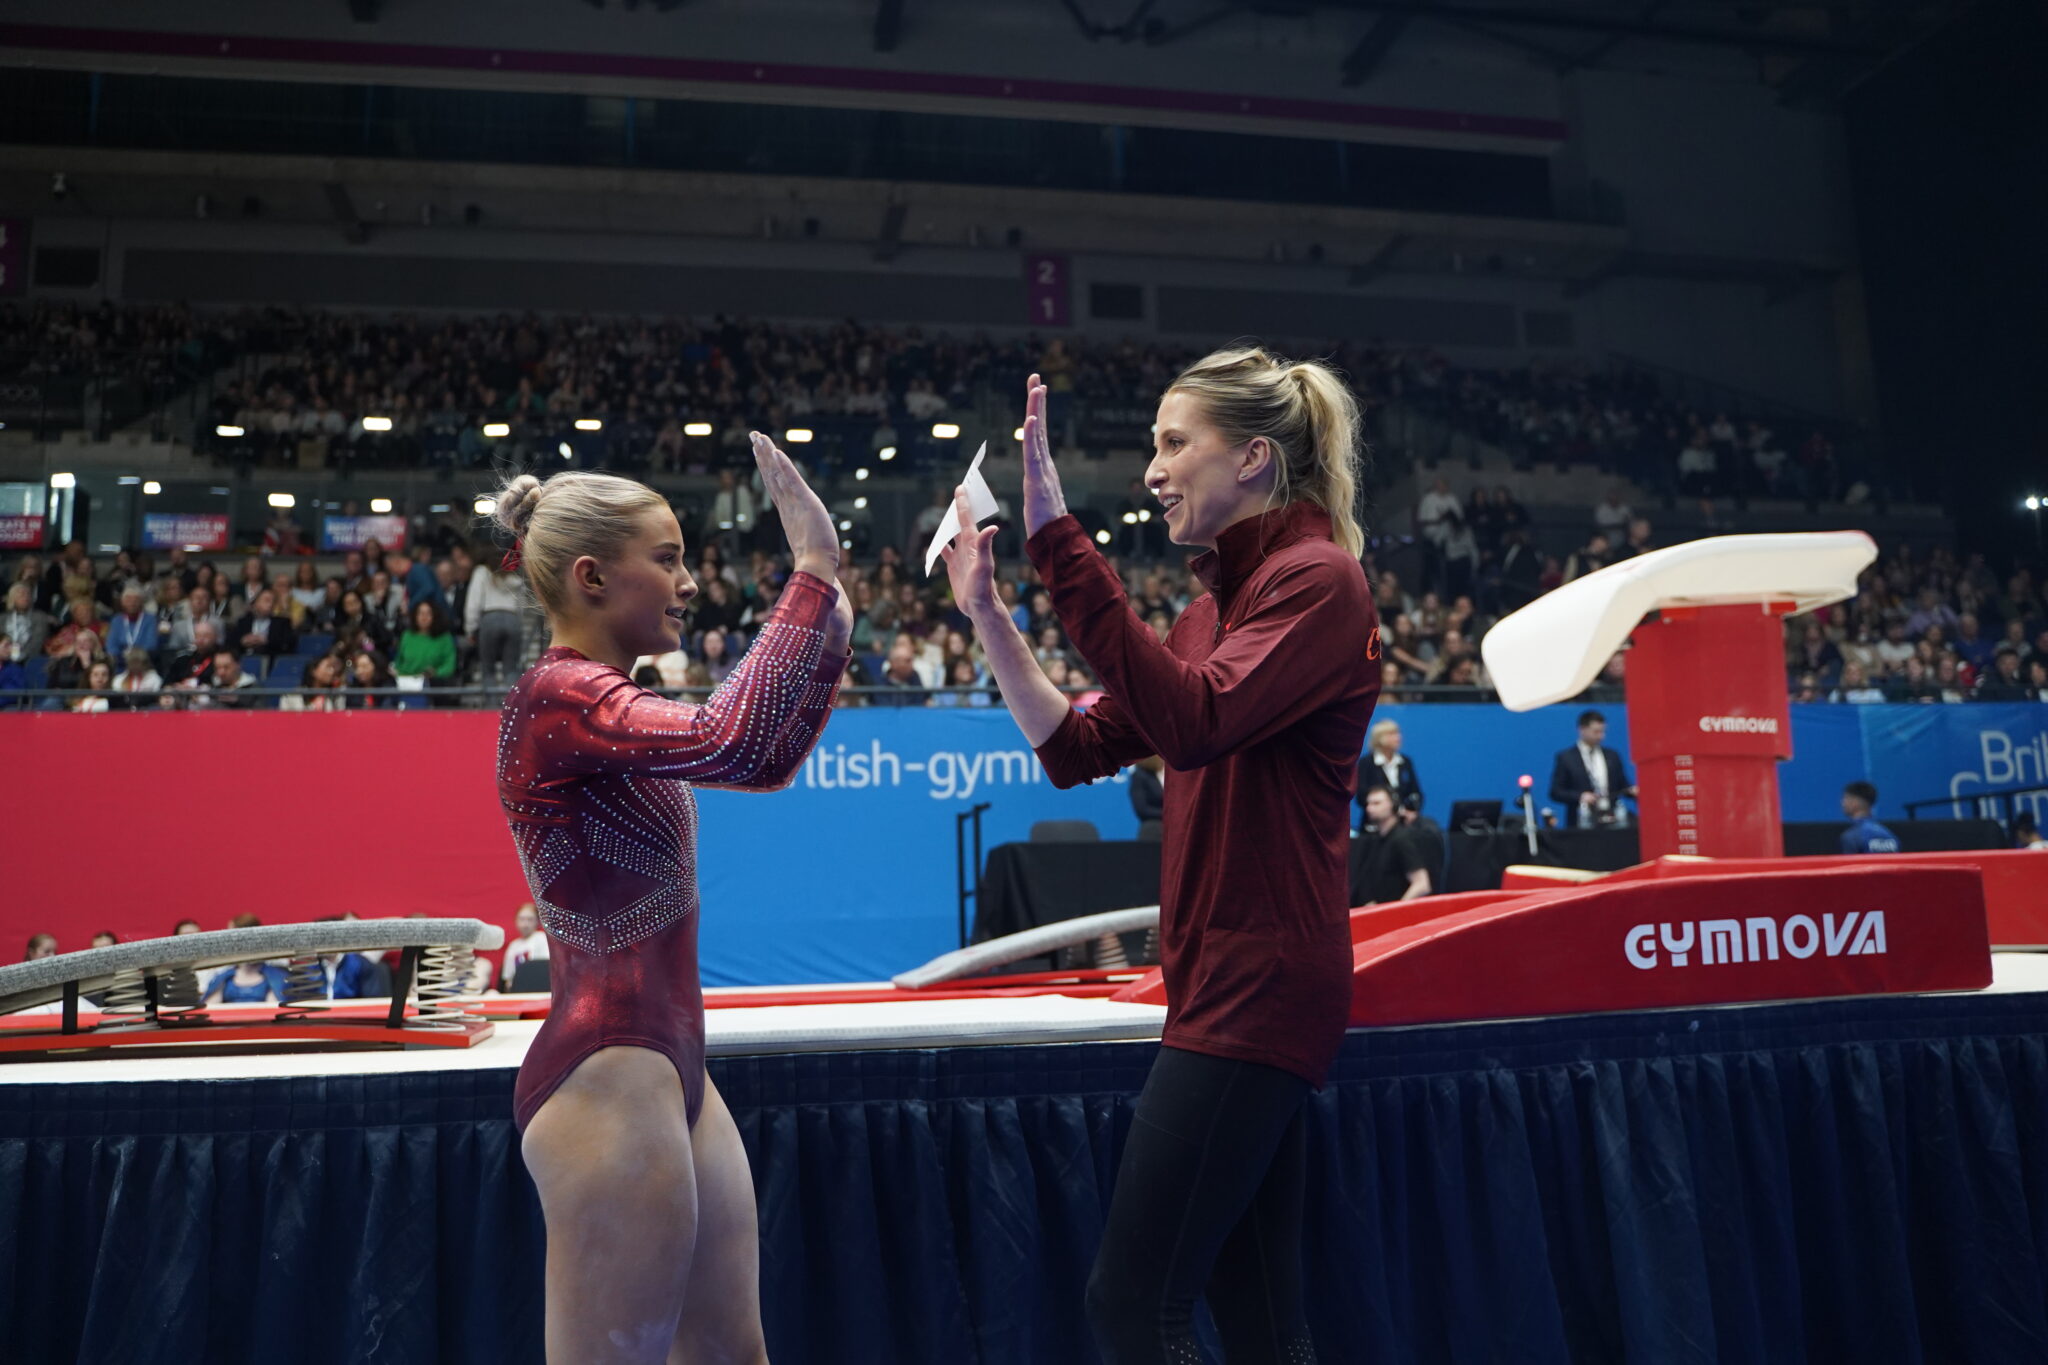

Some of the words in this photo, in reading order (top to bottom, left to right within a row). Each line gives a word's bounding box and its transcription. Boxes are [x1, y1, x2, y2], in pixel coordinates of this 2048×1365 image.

[1037, 260, 1056, 285] 2
[1041, 297, 1054, 321] 1
[1698, 715, 1778, 734] GYMNOVA
[1624, 910, 1887, 970] GYMNOVA
